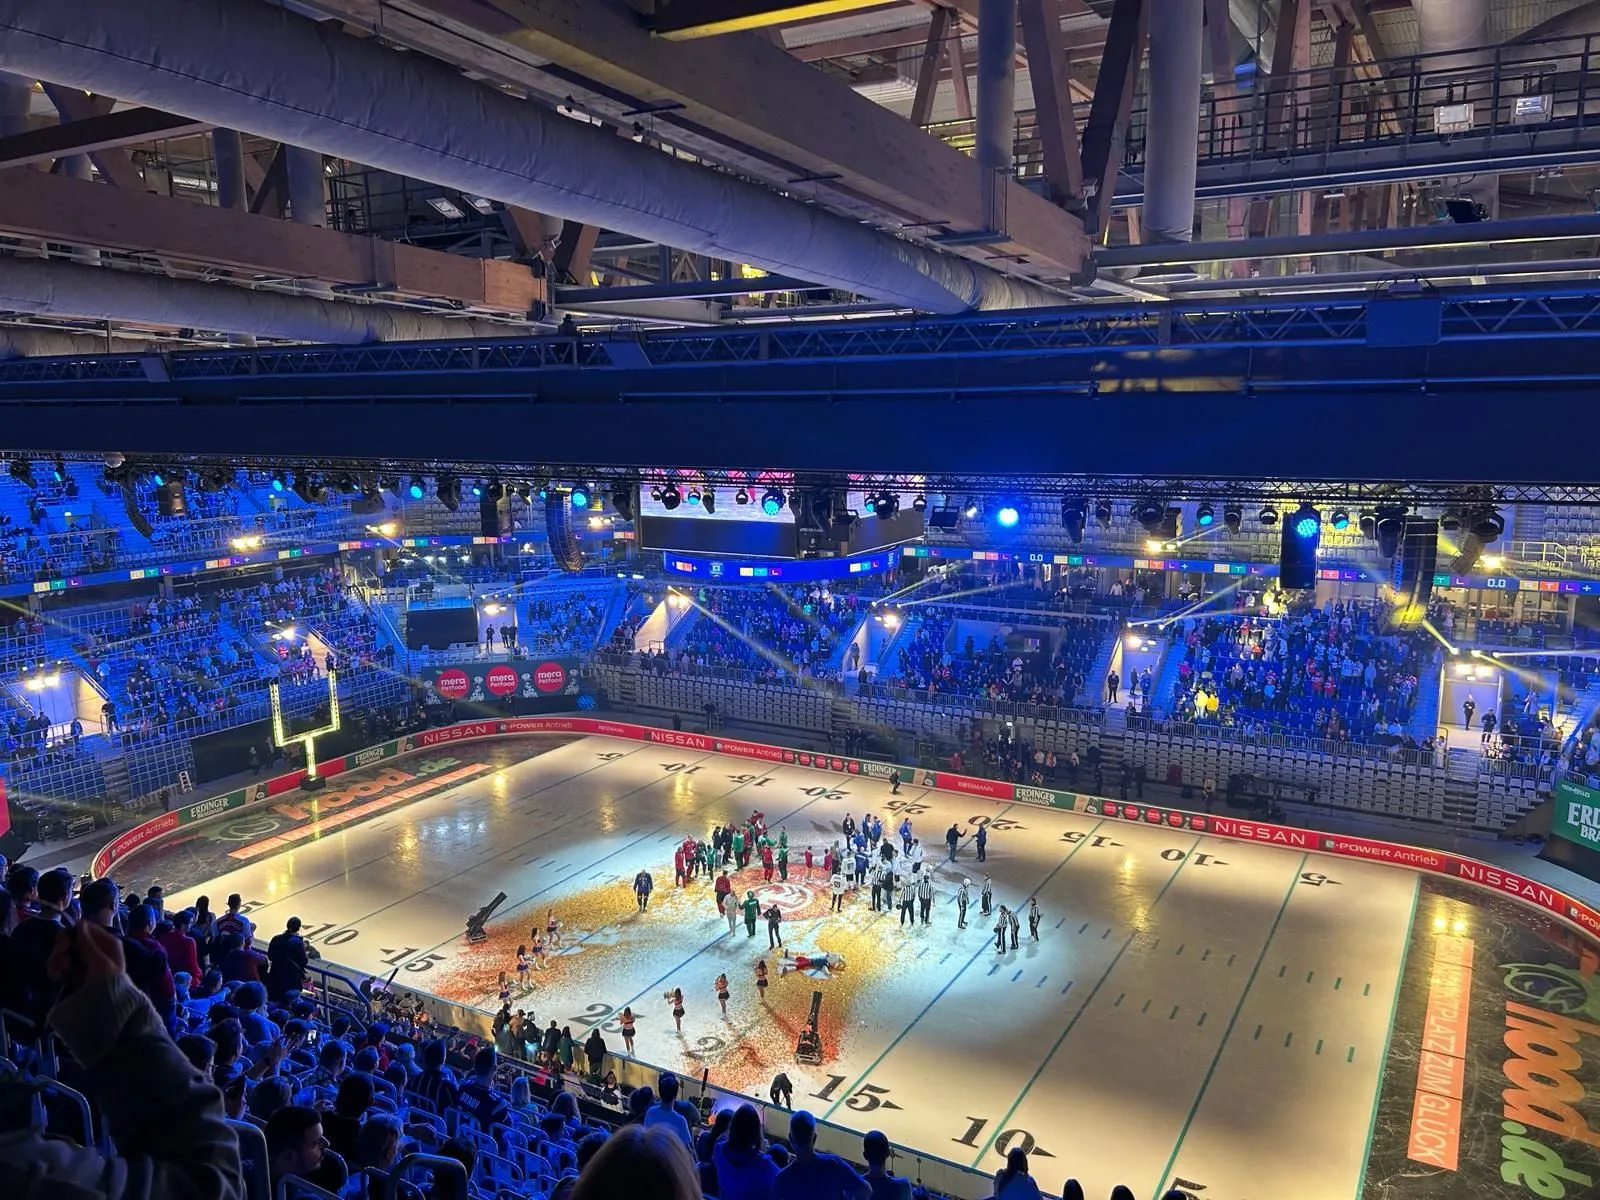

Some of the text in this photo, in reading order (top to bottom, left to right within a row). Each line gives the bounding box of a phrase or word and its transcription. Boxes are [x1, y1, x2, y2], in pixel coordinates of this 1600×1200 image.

[1487, 579, 1506, 588] 0.0
[440, 678, 466, 686] mera
[490, 674, 514, 682] mera
[538, 670, 562, 678] mera
[424, 725, 487, 744] NISSAN
[651, 731, 705, 747] NISSAN
[354, 748, 385, 763] ERDINGER
[756, 748, 782, 759] Antrieb
[1016, 788, 1056, 804] ERDINGER
[190, 797, 229, 818] ERDINGER
[1215, 820, 1305, 845] NISSAN
[1325, 840, 1439, 866] e-POWER Antrieb
[1459, 863, 1554, 906] NISSAN
[380, 947, 448, 972] 15
[1421, 1051, 1454, 1096] ZUM
[808, 1074, 890, 1112] 15
[952, 1116, 1035, 1158] 10
[1411, 1094, 1456, 1166] GLÜCK
